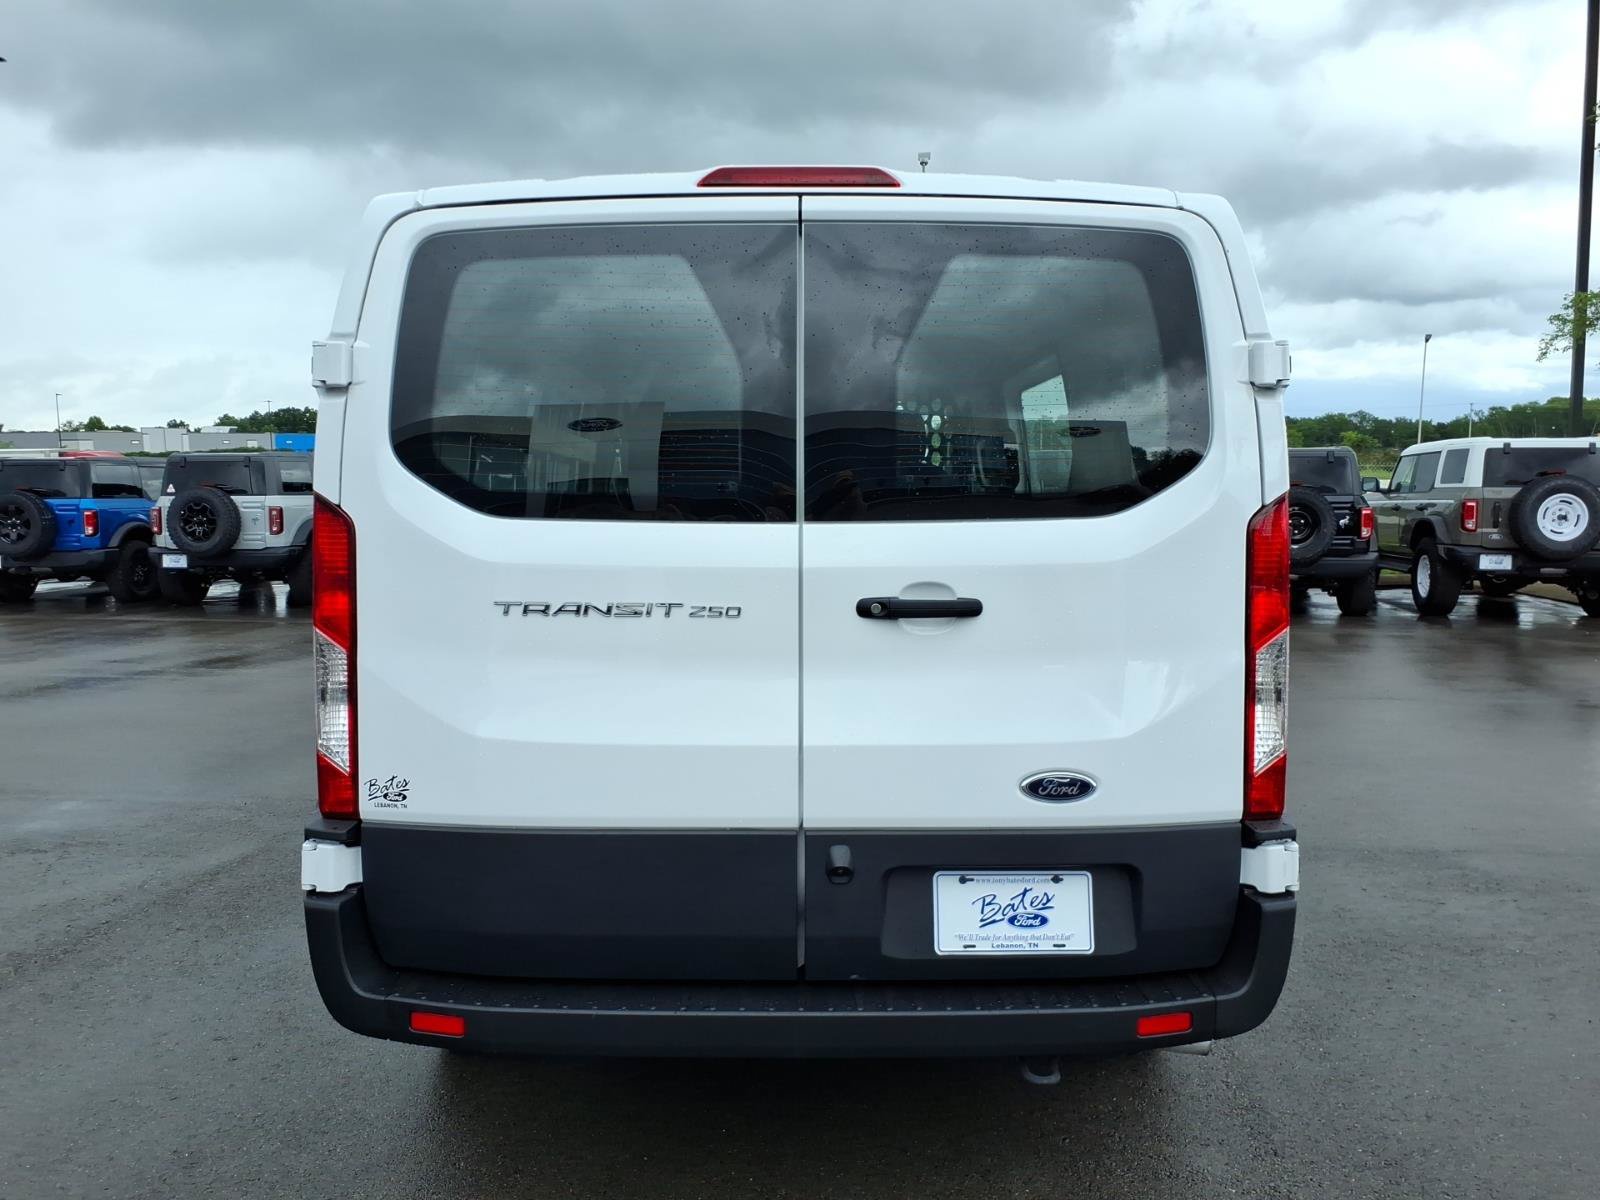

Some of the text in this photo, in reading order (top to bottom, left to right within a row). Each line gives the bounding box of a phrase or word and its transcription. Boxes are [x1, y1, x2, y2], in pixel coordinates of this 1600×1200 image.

[494, 601, 742, 619] TRANSIT 250
[363, 775, 411, 797] Bates
[1038, 777, 1081, 795] Ford
[972, 887, 1055, 923] Bates
[1014, 912, 1041, 926] Ford
[974, 933, 991, 941] Trade
[991, 933, 1002, 942] for
[1002, 933, 1029, 942] Anything
[1030, 933, 1042, 941] that
